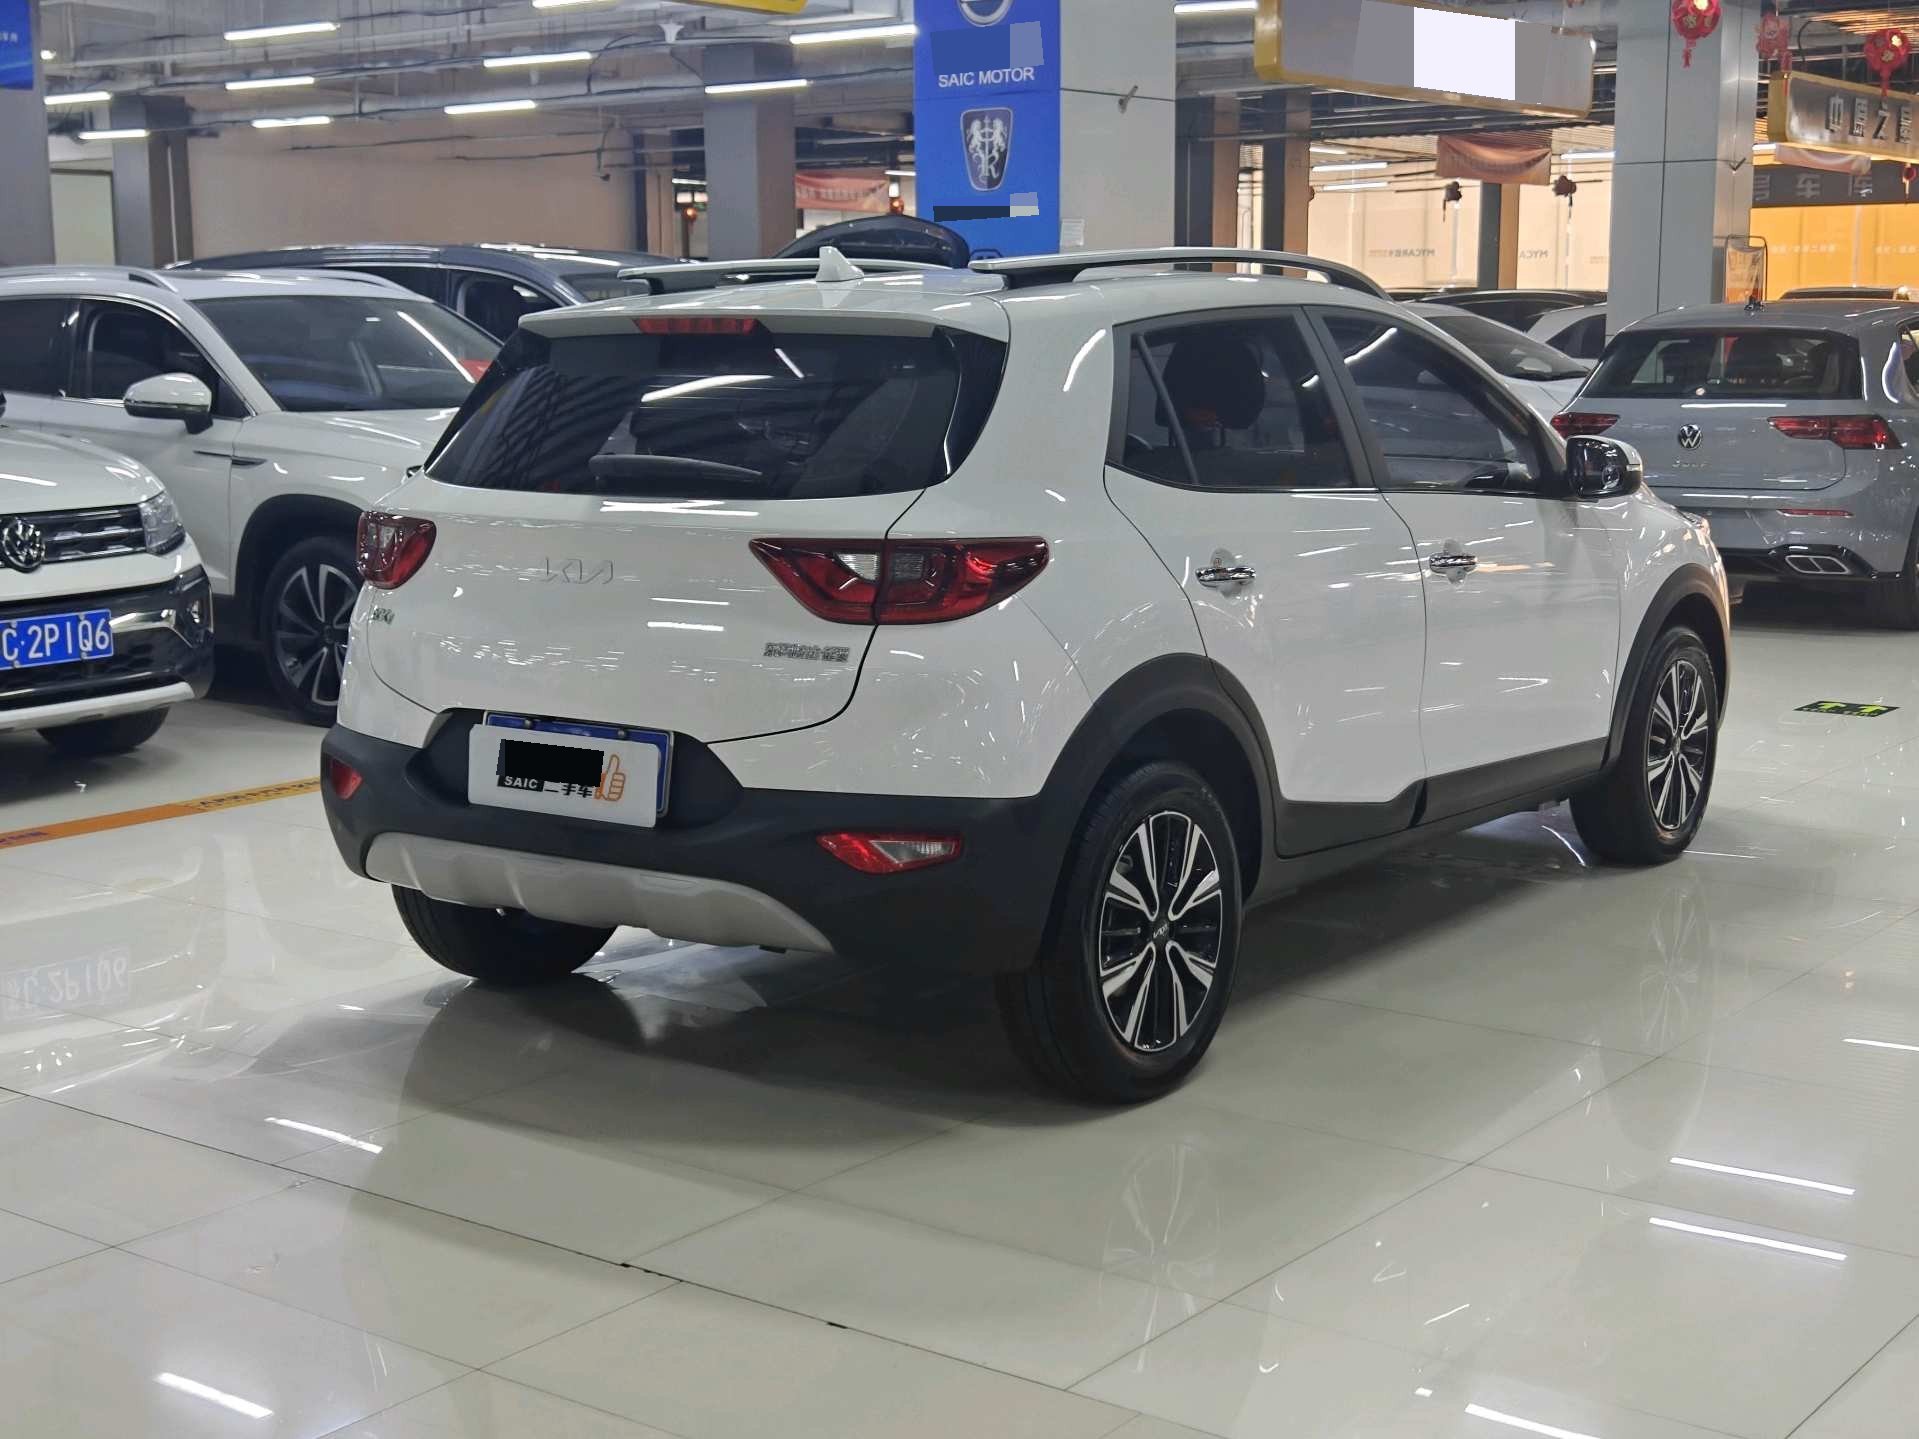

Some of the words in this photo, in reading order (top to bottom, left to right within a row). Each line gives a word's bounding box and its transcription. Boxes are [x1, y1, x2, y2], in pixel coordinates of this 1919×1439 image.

[938, 71, 975, 88] SAIC
[978, 66, 1035, 85] MOTOR
[503, 775, 539, 790] SAIC
